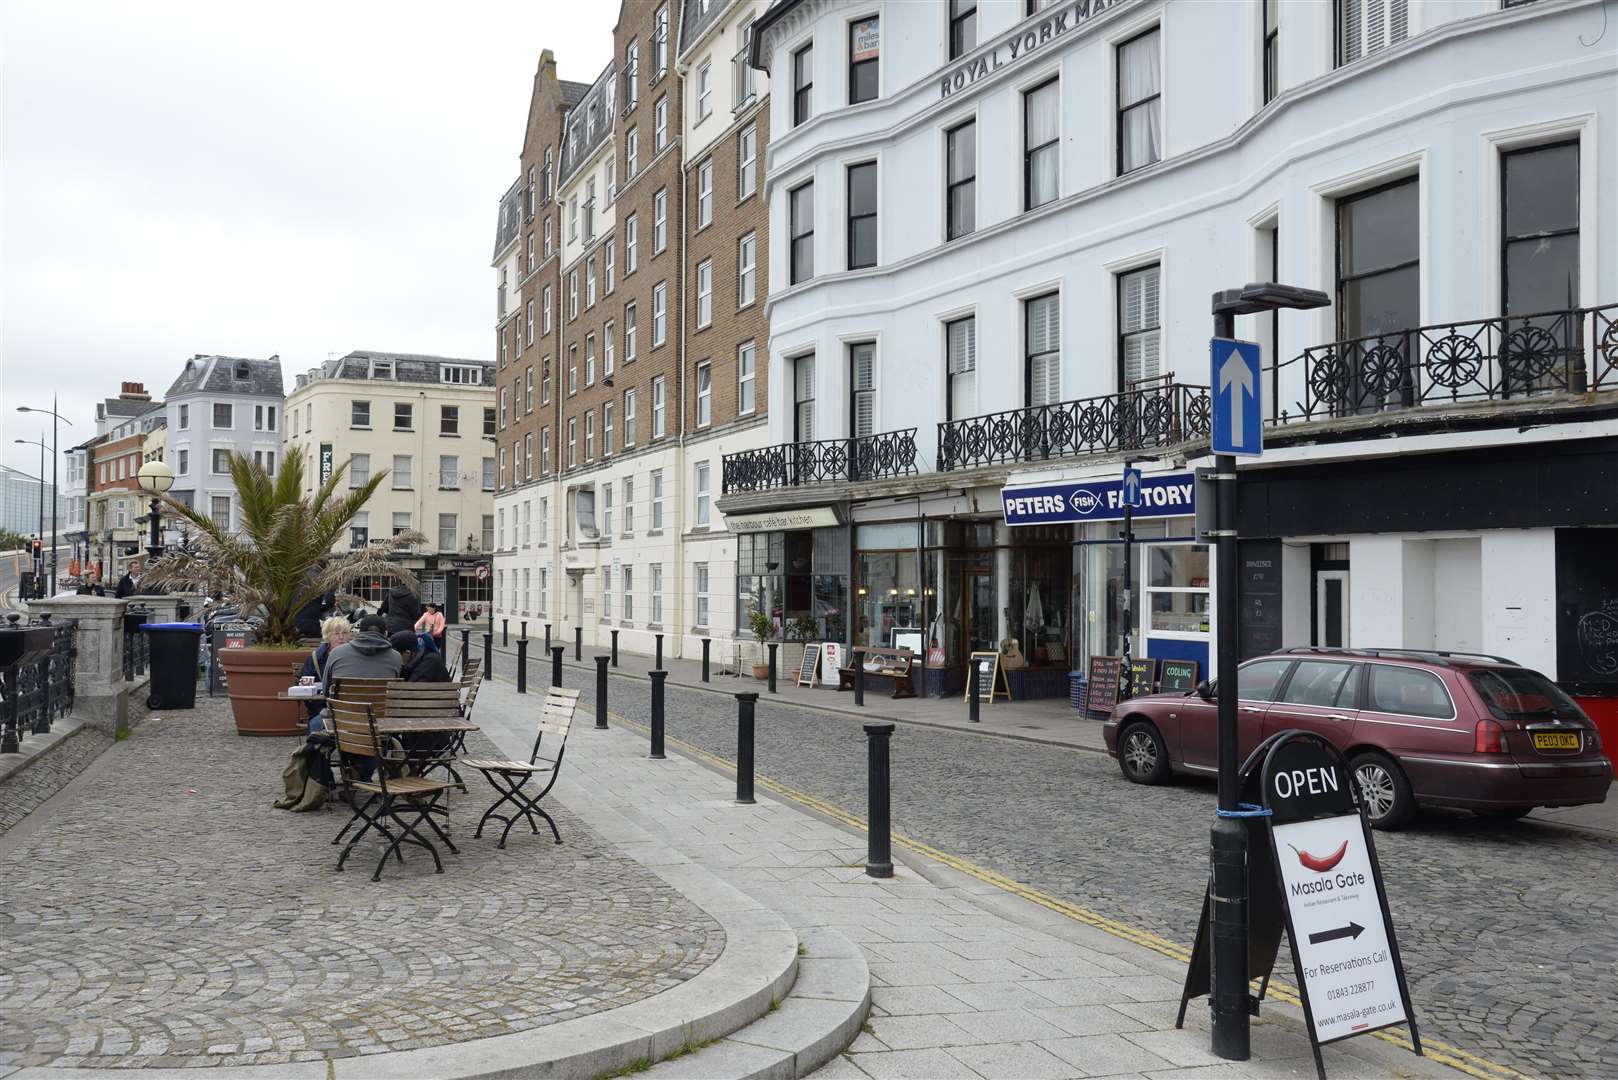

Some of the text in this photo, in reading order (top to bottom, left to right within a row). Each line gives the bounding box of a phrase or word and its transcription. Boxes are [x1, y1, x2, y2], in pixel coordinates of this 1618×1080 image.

[940, 52, 1003, 98] ROYAL
[1008, 12, 1068, 59] YORK
[1006, 494, 1066, 516] PETERS
[1074, 496, 1095, 508] FISH
[731, 521, 741, 530] the
[741, 520, 763, 530] harbour
[788, 514, 814, 525] kitchen
[1275, 766, 1338, 798] OPEN
[1291, 871, 1365, 897] Masala Gate
[1303, 949, 1388, 979] For Reservations Call
[1326, 980, 1375, 1001] 01843 228877
[1317, 999, 1397, 1028] www.masala-gate.co.uk
